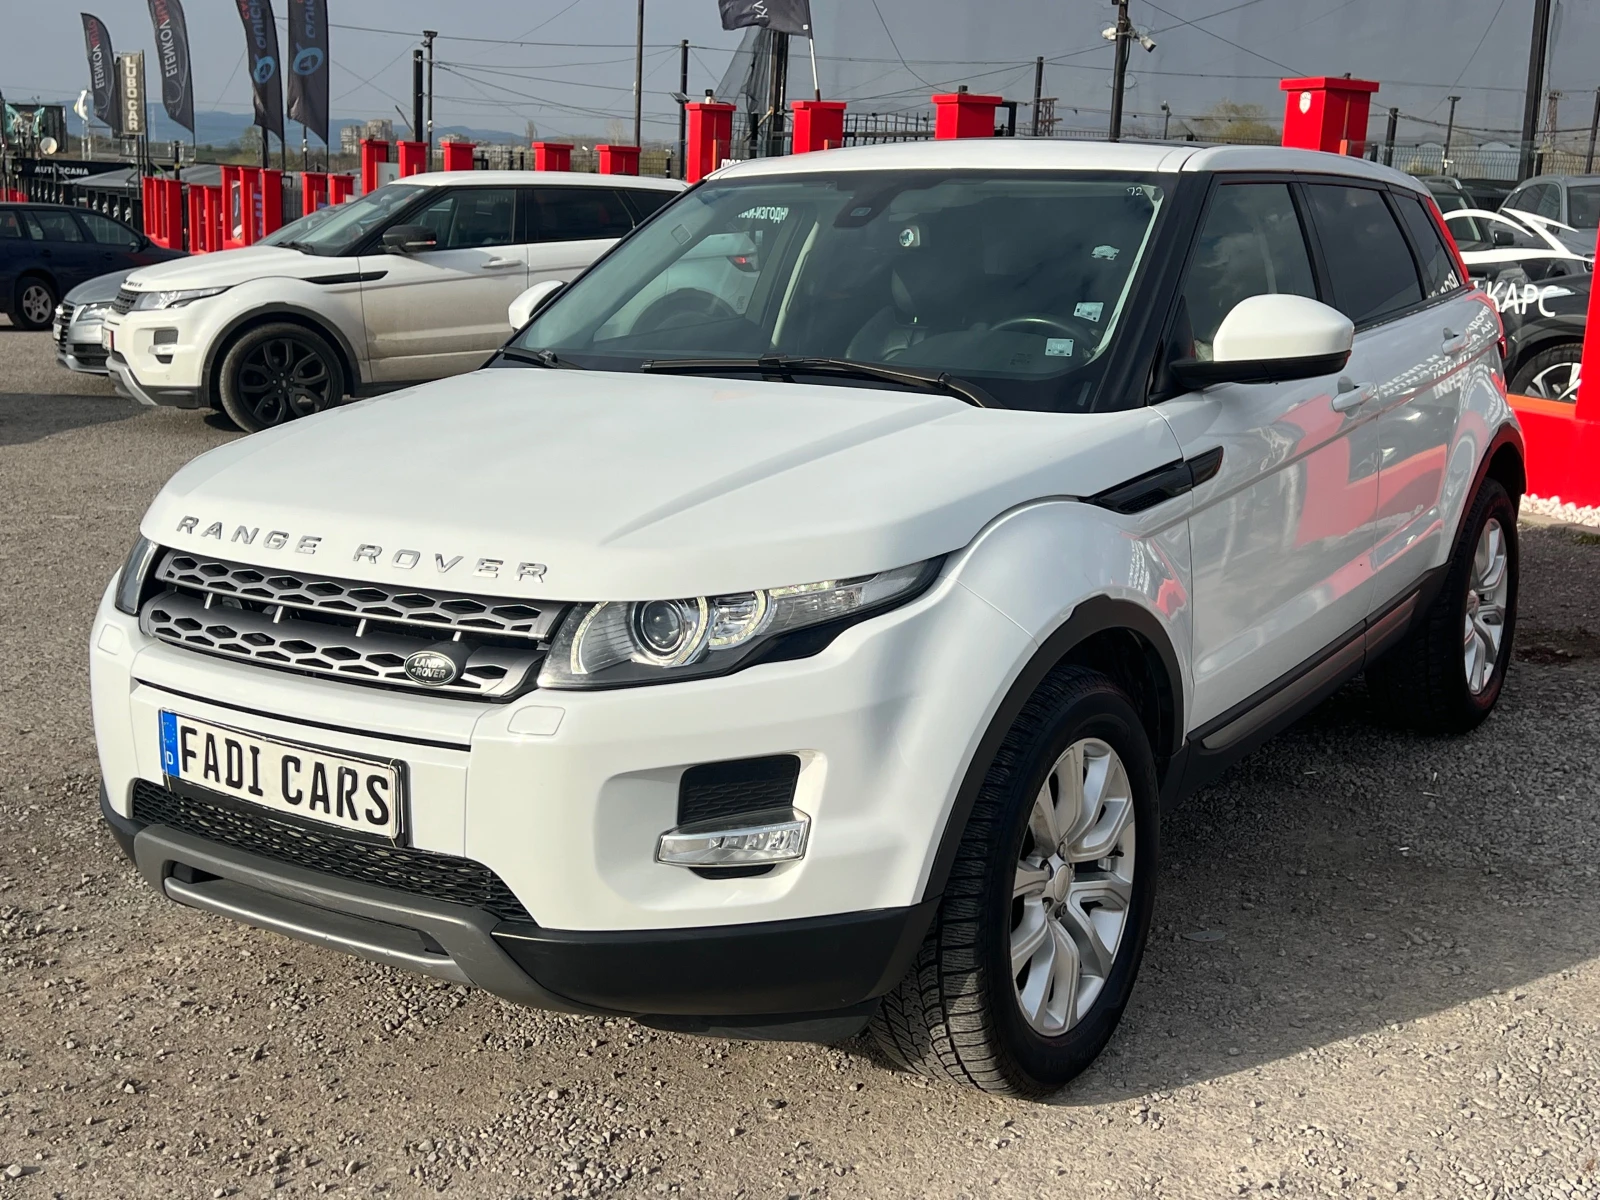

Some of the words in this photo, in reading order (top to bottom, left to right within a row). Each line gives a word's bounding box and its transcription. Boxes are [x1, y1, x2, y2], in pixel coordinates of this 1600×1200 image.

[125, 56, 137, 98] LUBO
[127, 100, 139, 131] CAR
[176, 515, 322, 554] RANGE
[353, 543, 548, 584] ROVER
[414, 658, 441, 669] LAND
[415, 668, 446, 678] ROVER
[166, 750, 174, 765] D
[180, 725, 263, 797] FADI
[281, 754, 390, 826] CARS
